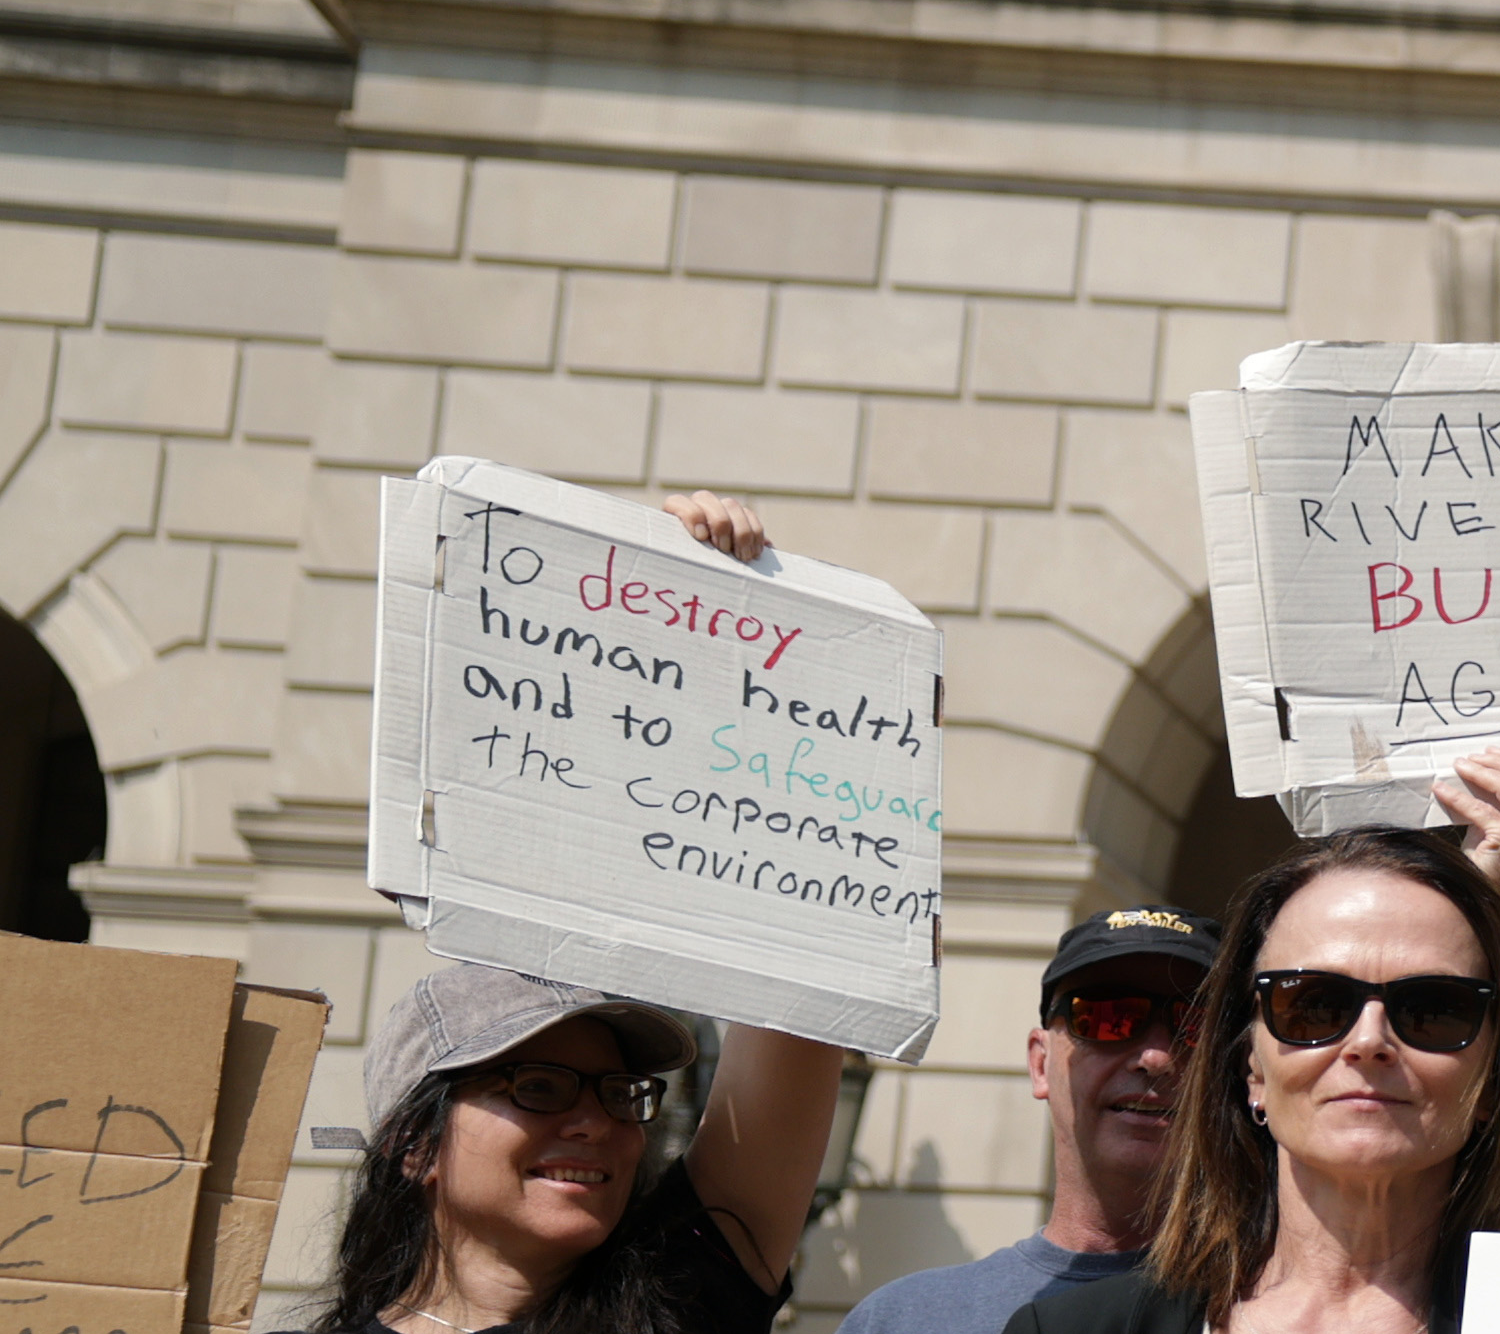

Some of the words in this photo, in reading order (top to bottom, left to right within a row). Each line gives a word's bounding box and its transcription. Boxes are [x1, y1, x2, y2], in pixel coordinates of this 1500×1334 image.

[579, 545, 803, 670] destroy
[463, 664, 575, 720] and
[612, 704, 673, 748] to
[480, 586, 684, 691] human
[743, 669, 922, 758] health
[471, 724, 591, 790] the
[625, 776, 899, 870] corporate
[642, 831, 942, 925] environment
[0, 1096, 186, 1204] ED
